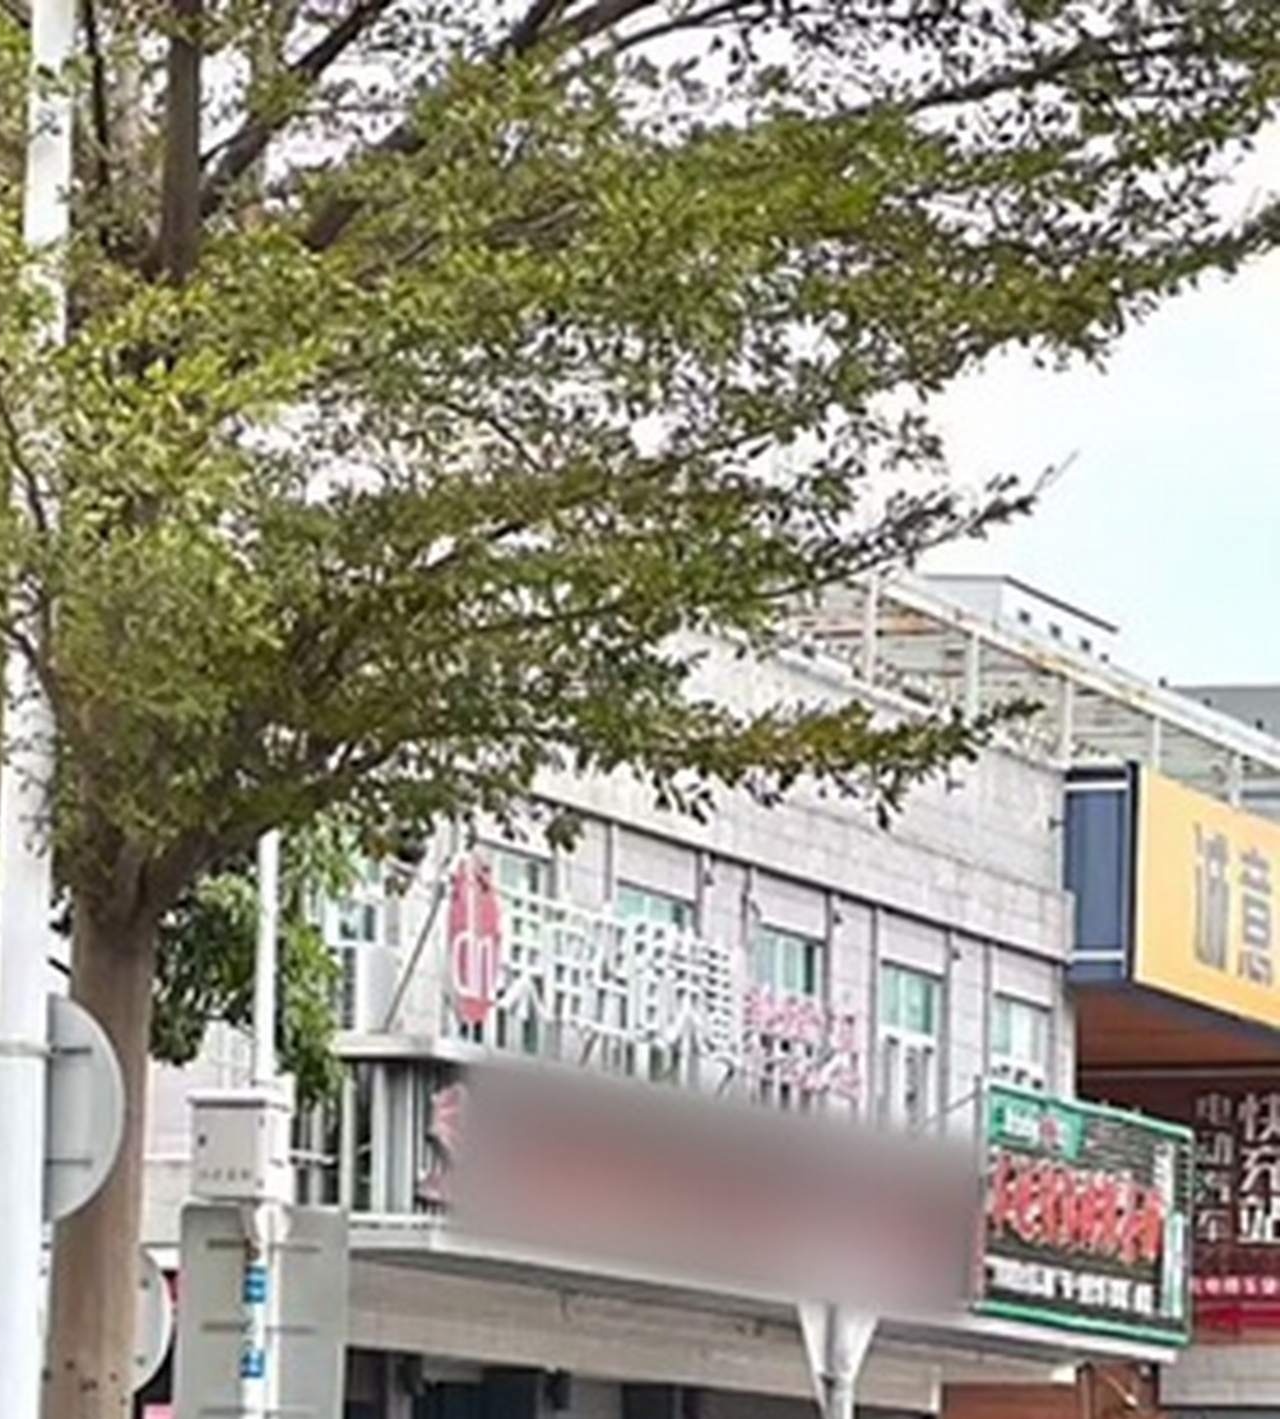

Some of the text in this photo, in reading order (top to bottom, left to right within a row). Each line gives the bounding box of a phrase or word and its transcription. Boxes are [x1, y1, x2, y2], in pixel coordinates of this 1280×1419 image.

[1195, 1092, 1234, 1242] 电动汽车
[1237, 1092, 1280, 1245] 快充站
